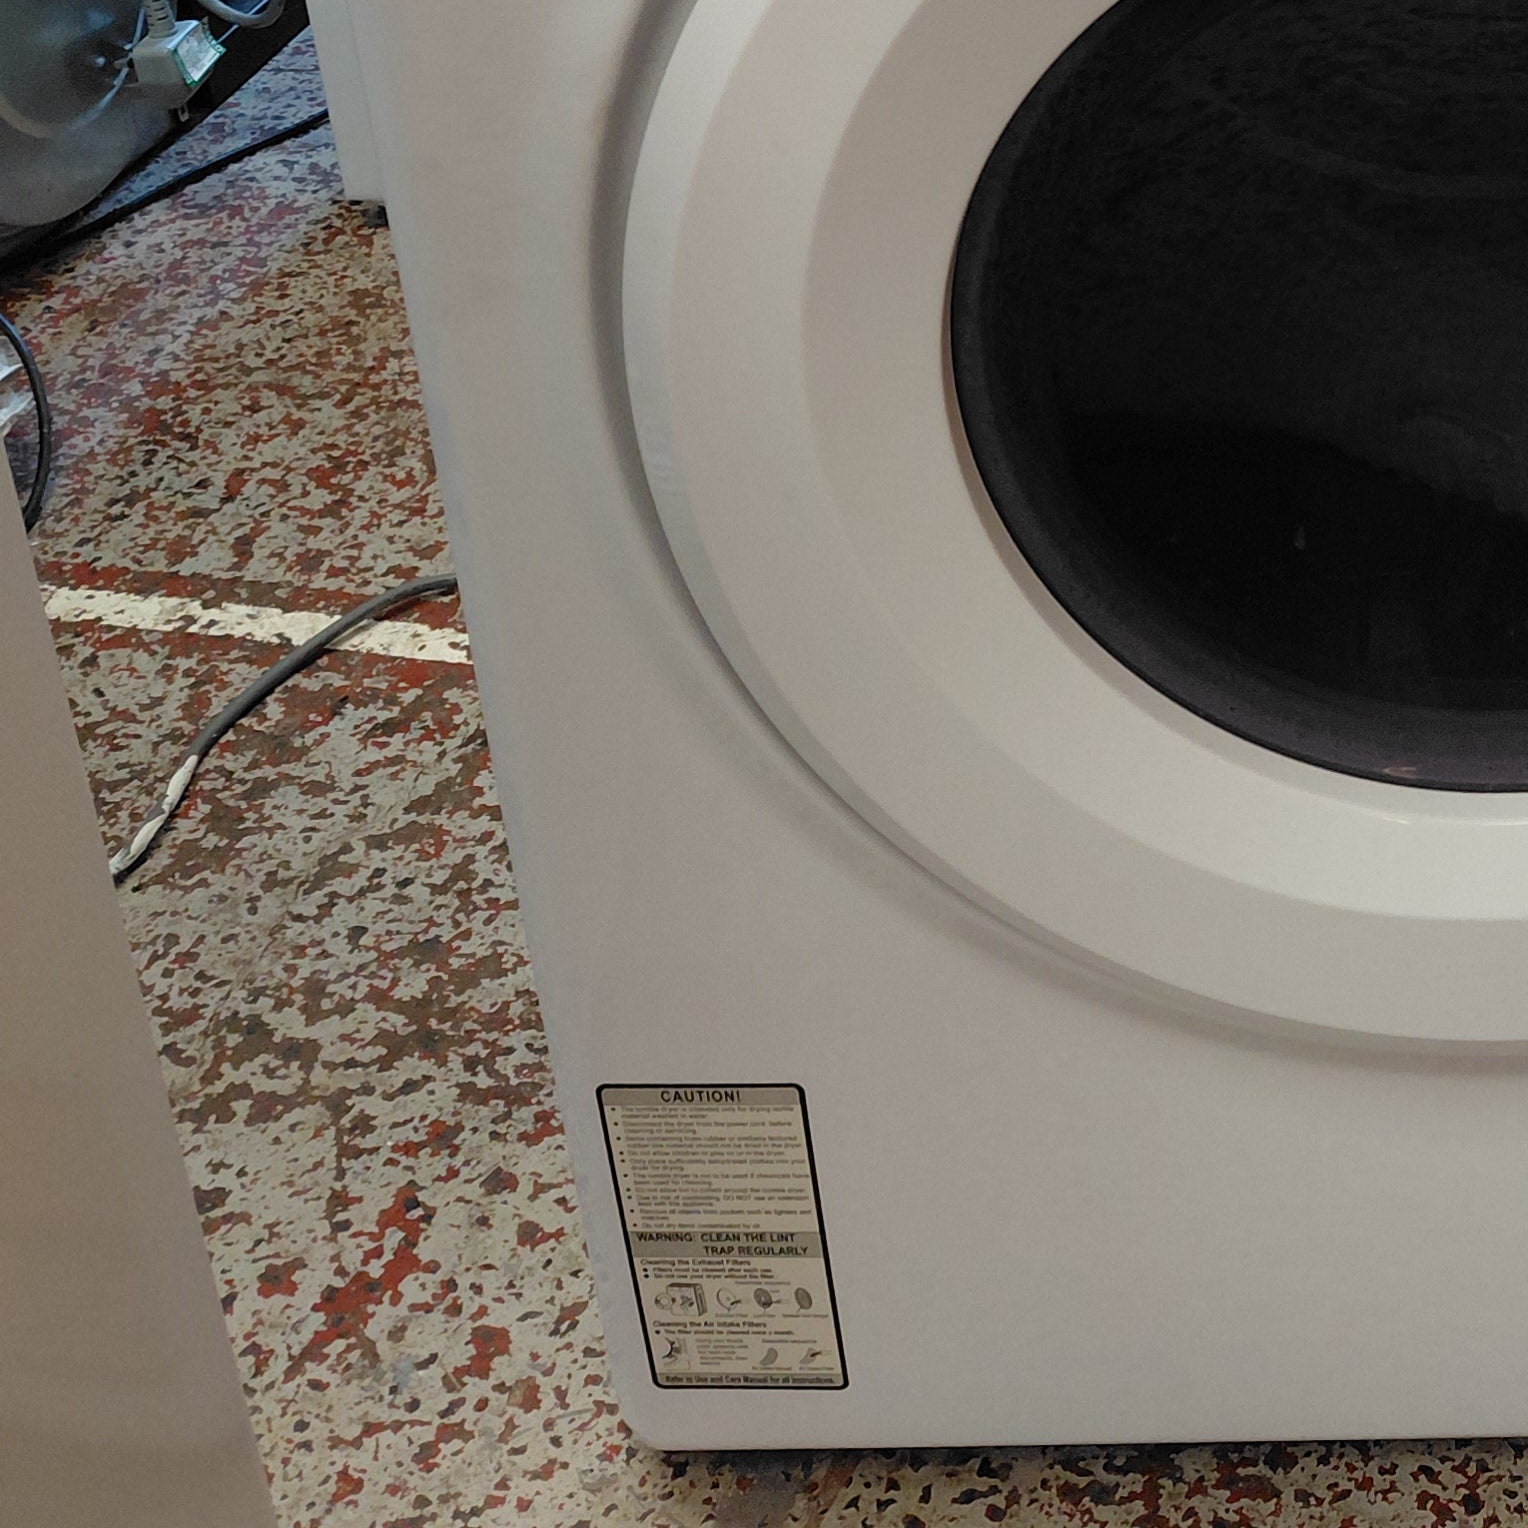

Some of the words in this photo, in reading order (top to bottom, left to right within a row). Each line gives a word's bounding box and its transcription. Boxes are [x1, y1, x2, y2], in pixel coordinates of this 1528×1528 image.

[660, 1090, 740, 1103] CAUTION!
[637, 1232, 696, 1243] WARNING:
[701, 1232, 741, 1243] CLEAN
[743, 1232, 767, 1243] THE
[770, 1232, 796, 1243] LINT
[704, 1246, 735, 1256] TRAP
[738, 1246, 808, 1256] REGULARLY
